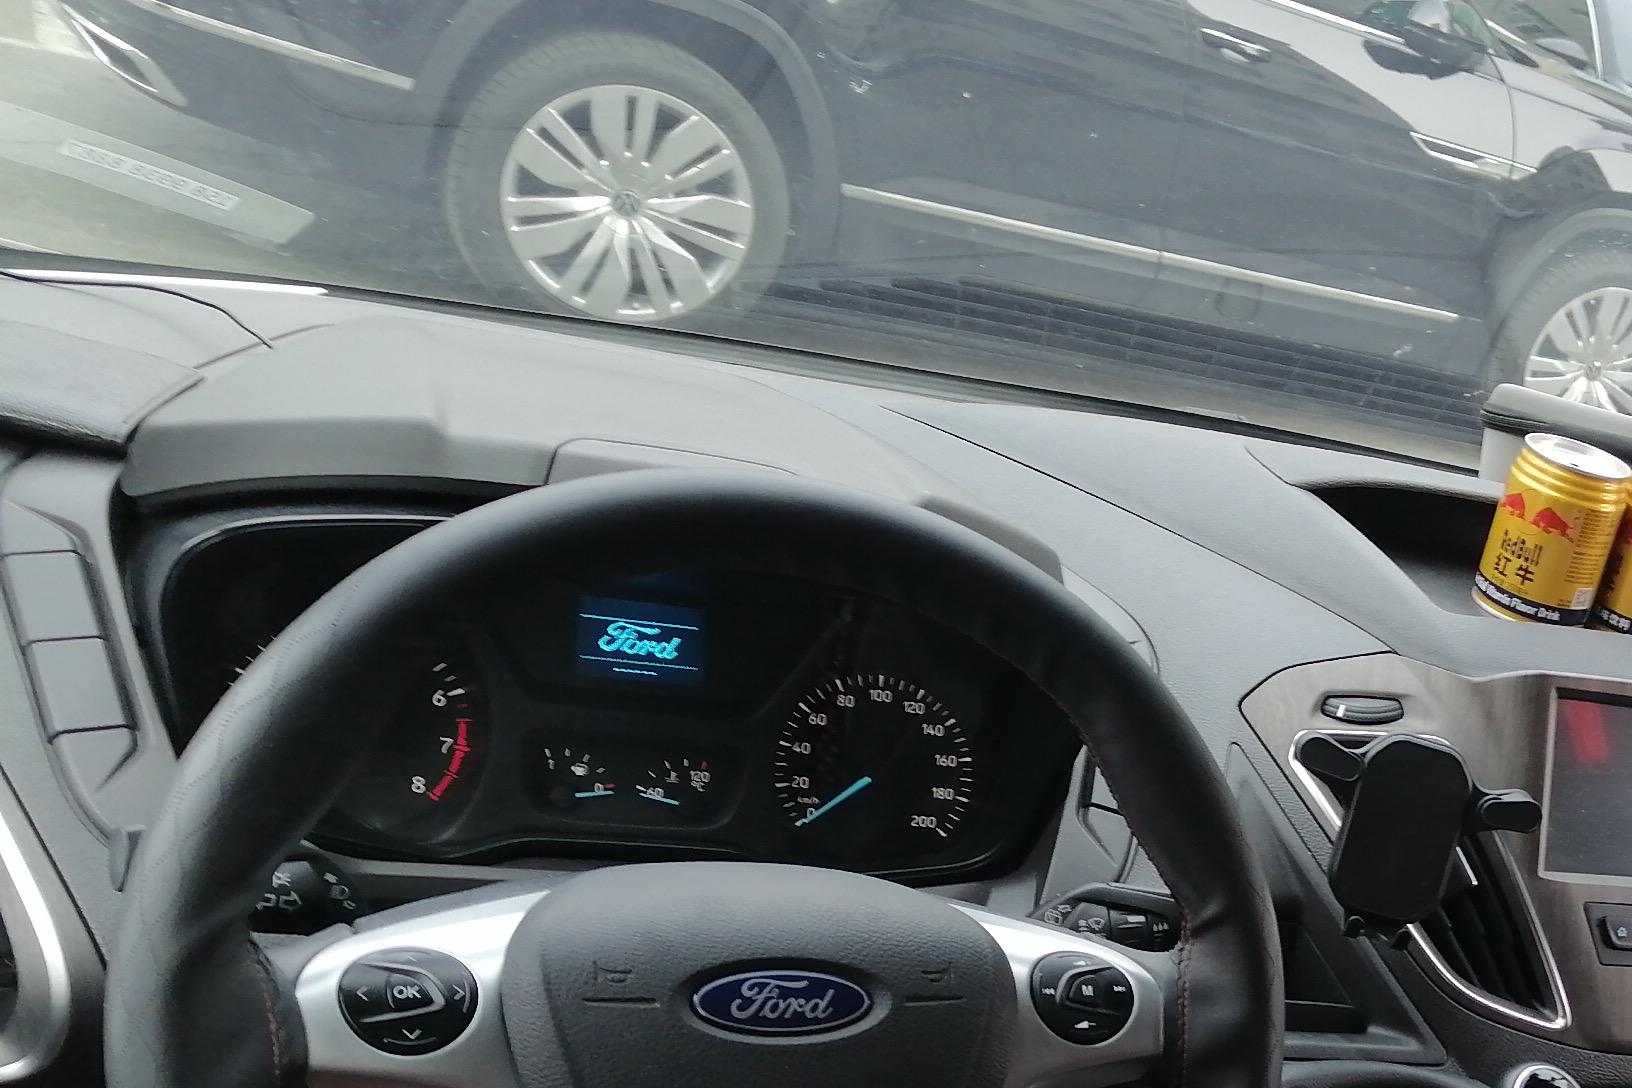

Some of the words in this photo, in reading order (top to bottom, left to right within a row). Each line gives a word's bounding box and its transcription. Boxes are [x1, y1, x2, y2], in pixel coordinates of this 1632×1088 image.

[1493, 553, 1535, 586] 红牛
[598, 621, 682, 660] Ford
[432, 689, 447, 707] 6
[836, 694, 856, 708] 80
[868, 689, 893, 703] 100
[903, 701, 926, 715] 120
[808, 713, 828, 726] 60
[922, 723, 946, 737] 140
[439, 736, 454, 754] 7
[792, 742, 812, 755] 40
[934, 754, 958, 767] 160
[411, 775, 426, 794] 8
[791, 776, 810, 789] 20
[931, 787, 955, 800] 180
[910, 815, 937, 829] 200
[393, 985, 422, 999] OK
[730, 978, 835, 1019] Ford
